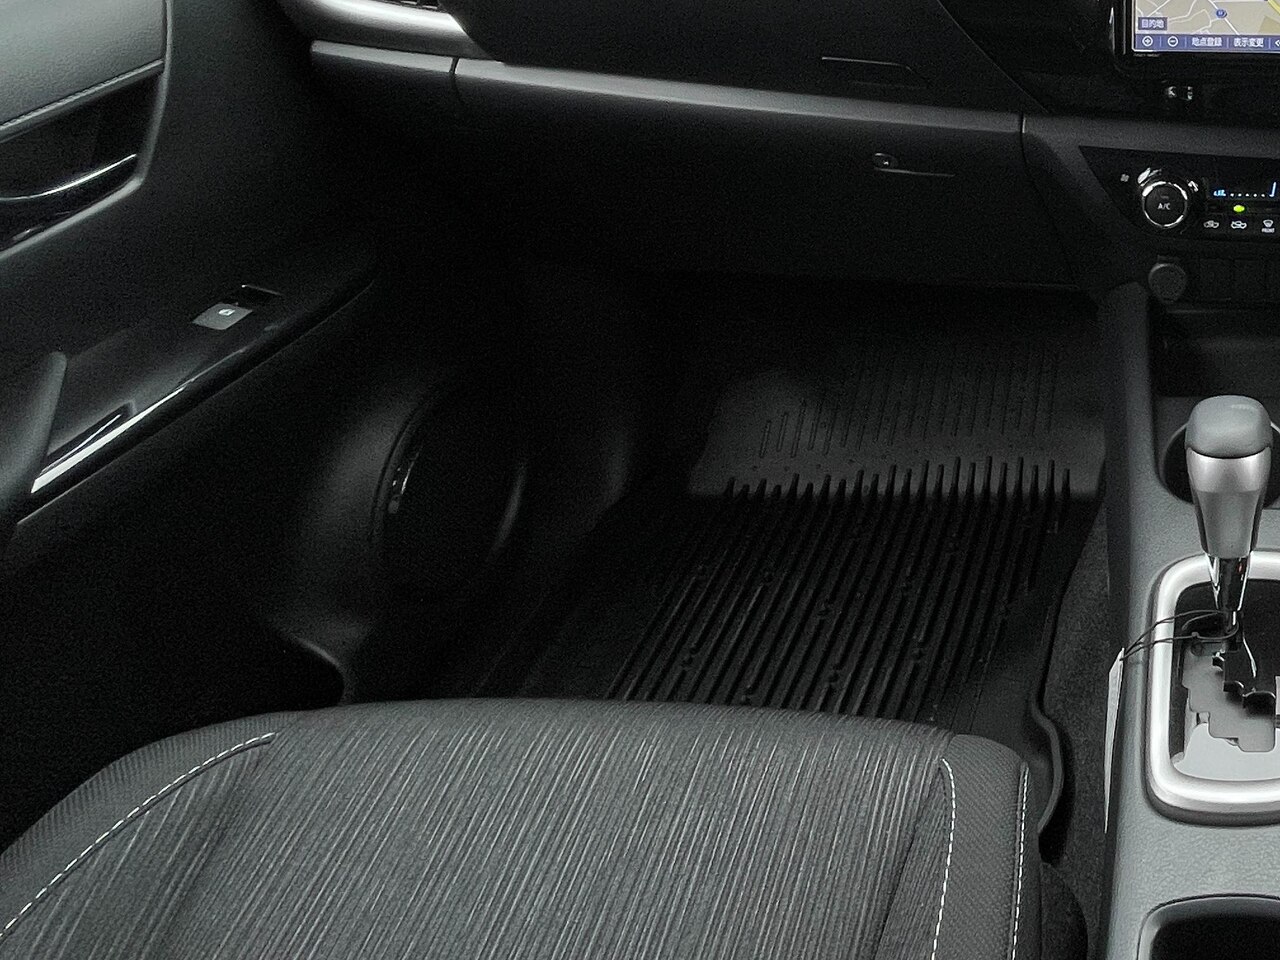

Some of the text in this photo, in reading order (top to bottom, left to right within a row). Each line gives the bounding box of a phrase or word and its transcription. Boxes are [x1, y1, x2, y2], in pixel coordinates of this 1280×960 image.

[1140, 18, 1165, 29] 目的地
[1191, 36, 1223, 48] 地点登録
[1233, 37, 1264, 48] 表示変更
[1157, 202, 1171, 211] A/C
